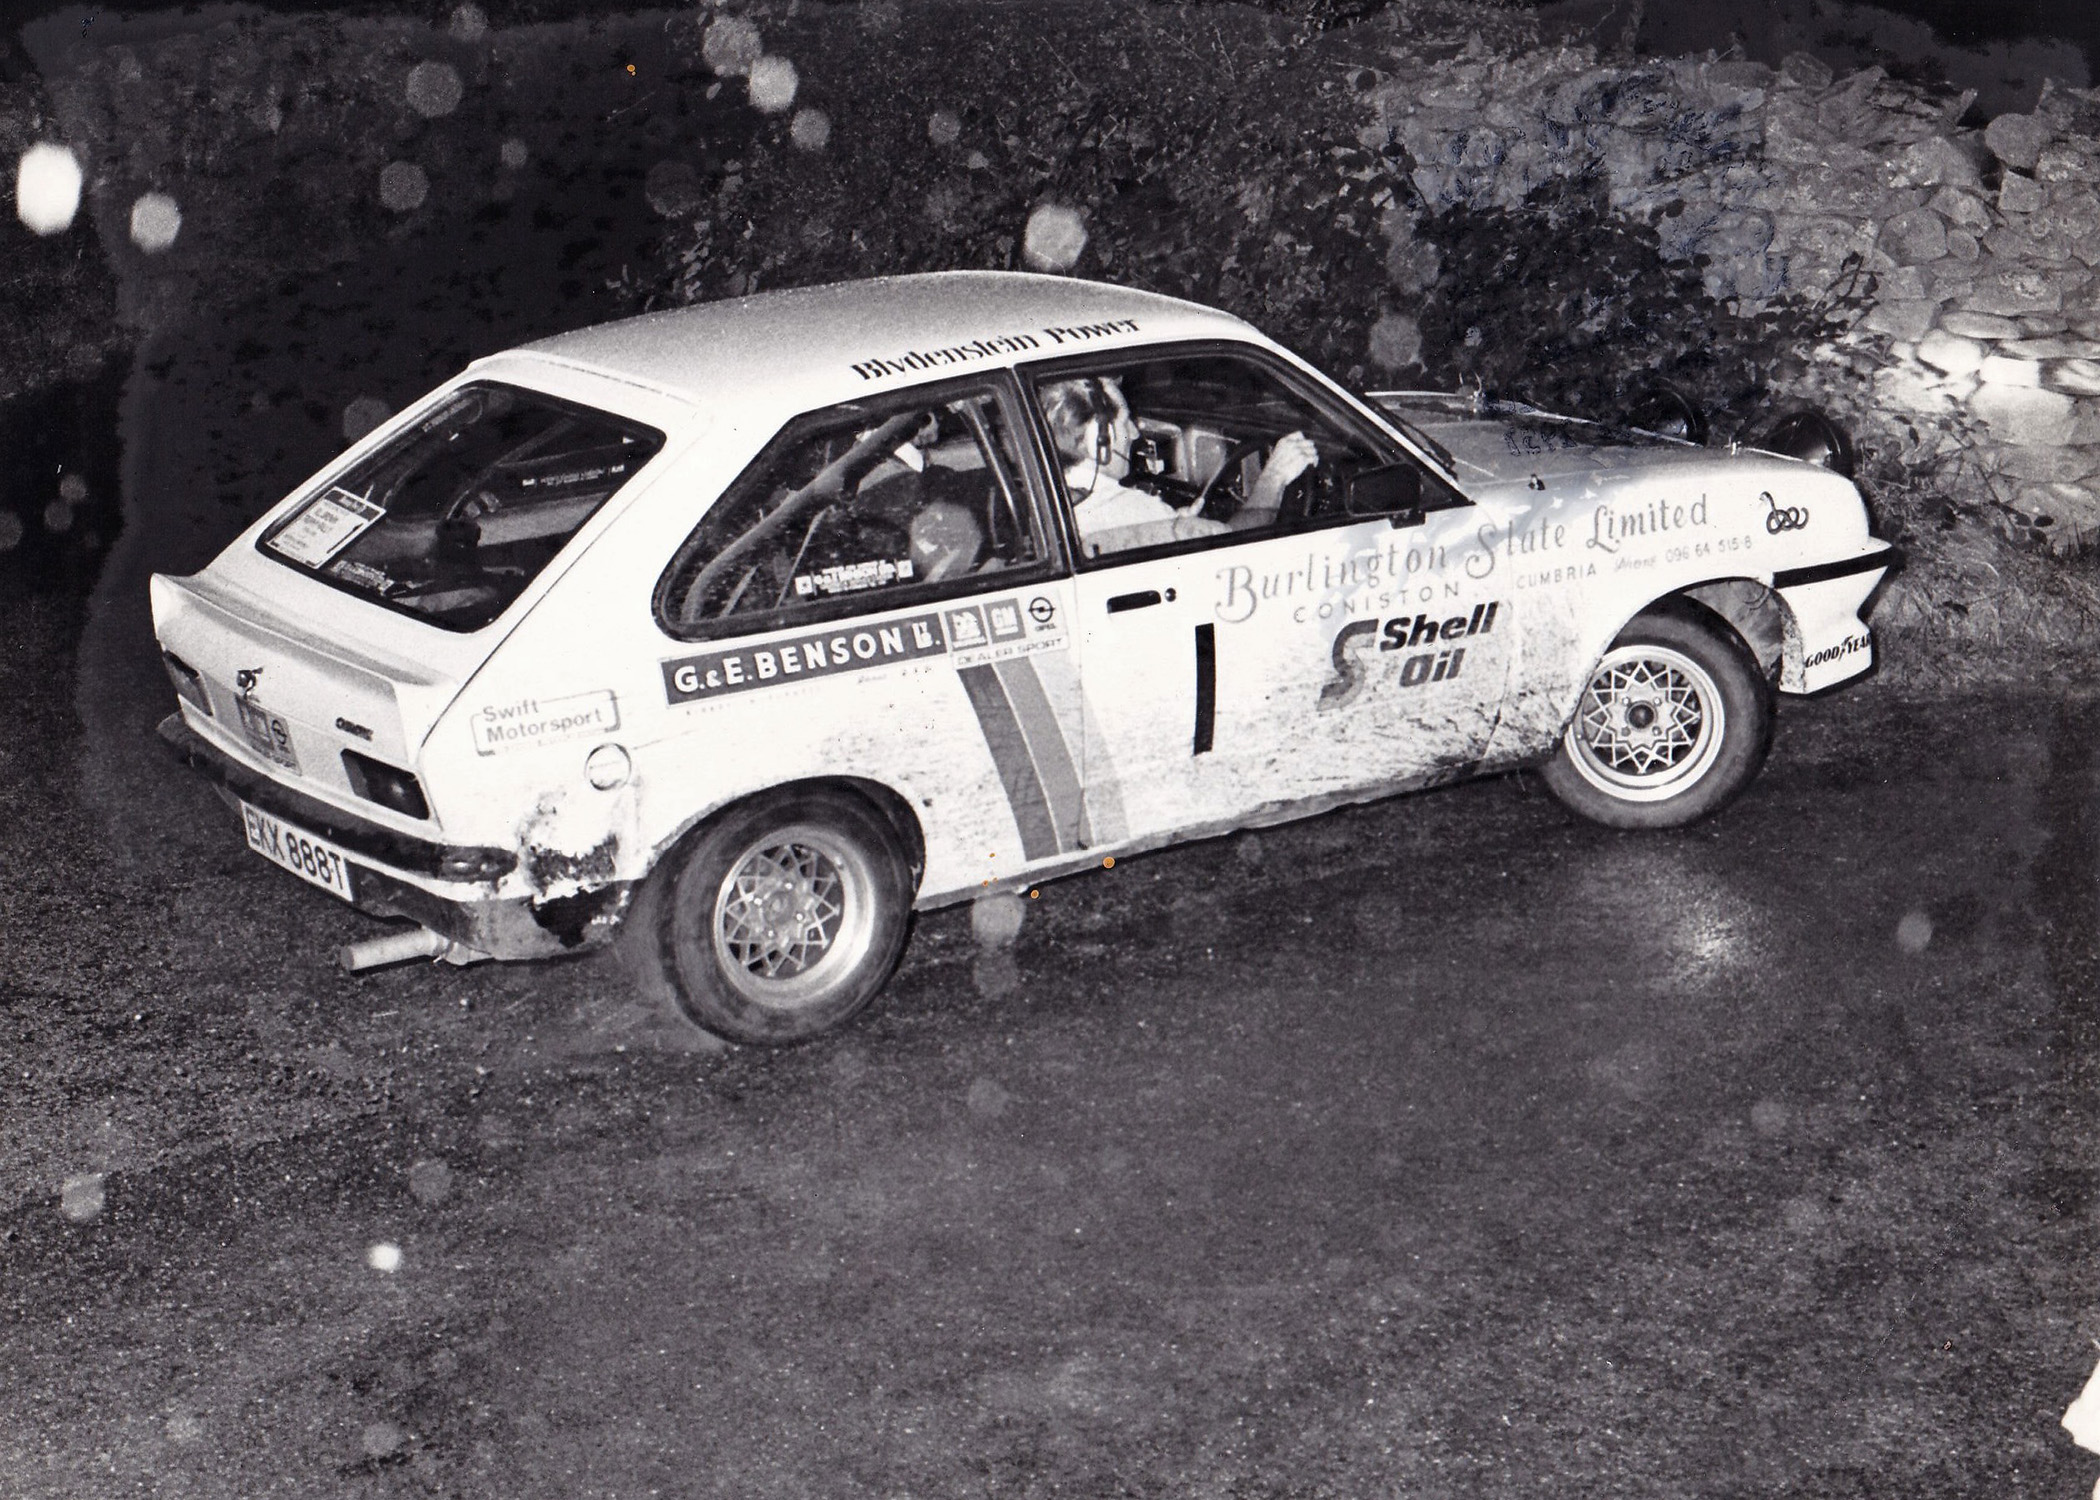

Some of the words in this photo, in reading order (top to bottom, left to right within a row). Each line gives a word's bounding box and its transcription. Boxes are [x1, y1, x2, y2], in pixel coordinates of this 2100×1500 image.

[850, 334, 1040, 380] Blydenstein
[1043, 318, 1140, 344] Power
[1215, 543, 1447, 624] Burlington
[1465, 520, 1566, 580] Slate
[1586, 493, 1708, 553] Limited
[1293, 581, 1459, 623] CONISTON
[1516, 563, 1597, 590] CUMBRIA
[1380, 601, 1499, 652] Shell
[1400, 648, 1466, 688] Oil
[483, 699, 539, 722] Swift
[487, 708, 602, 743] Motorsport
[246, 806, 285, 861] EKX
[286, 832, 343, 890] 888T
